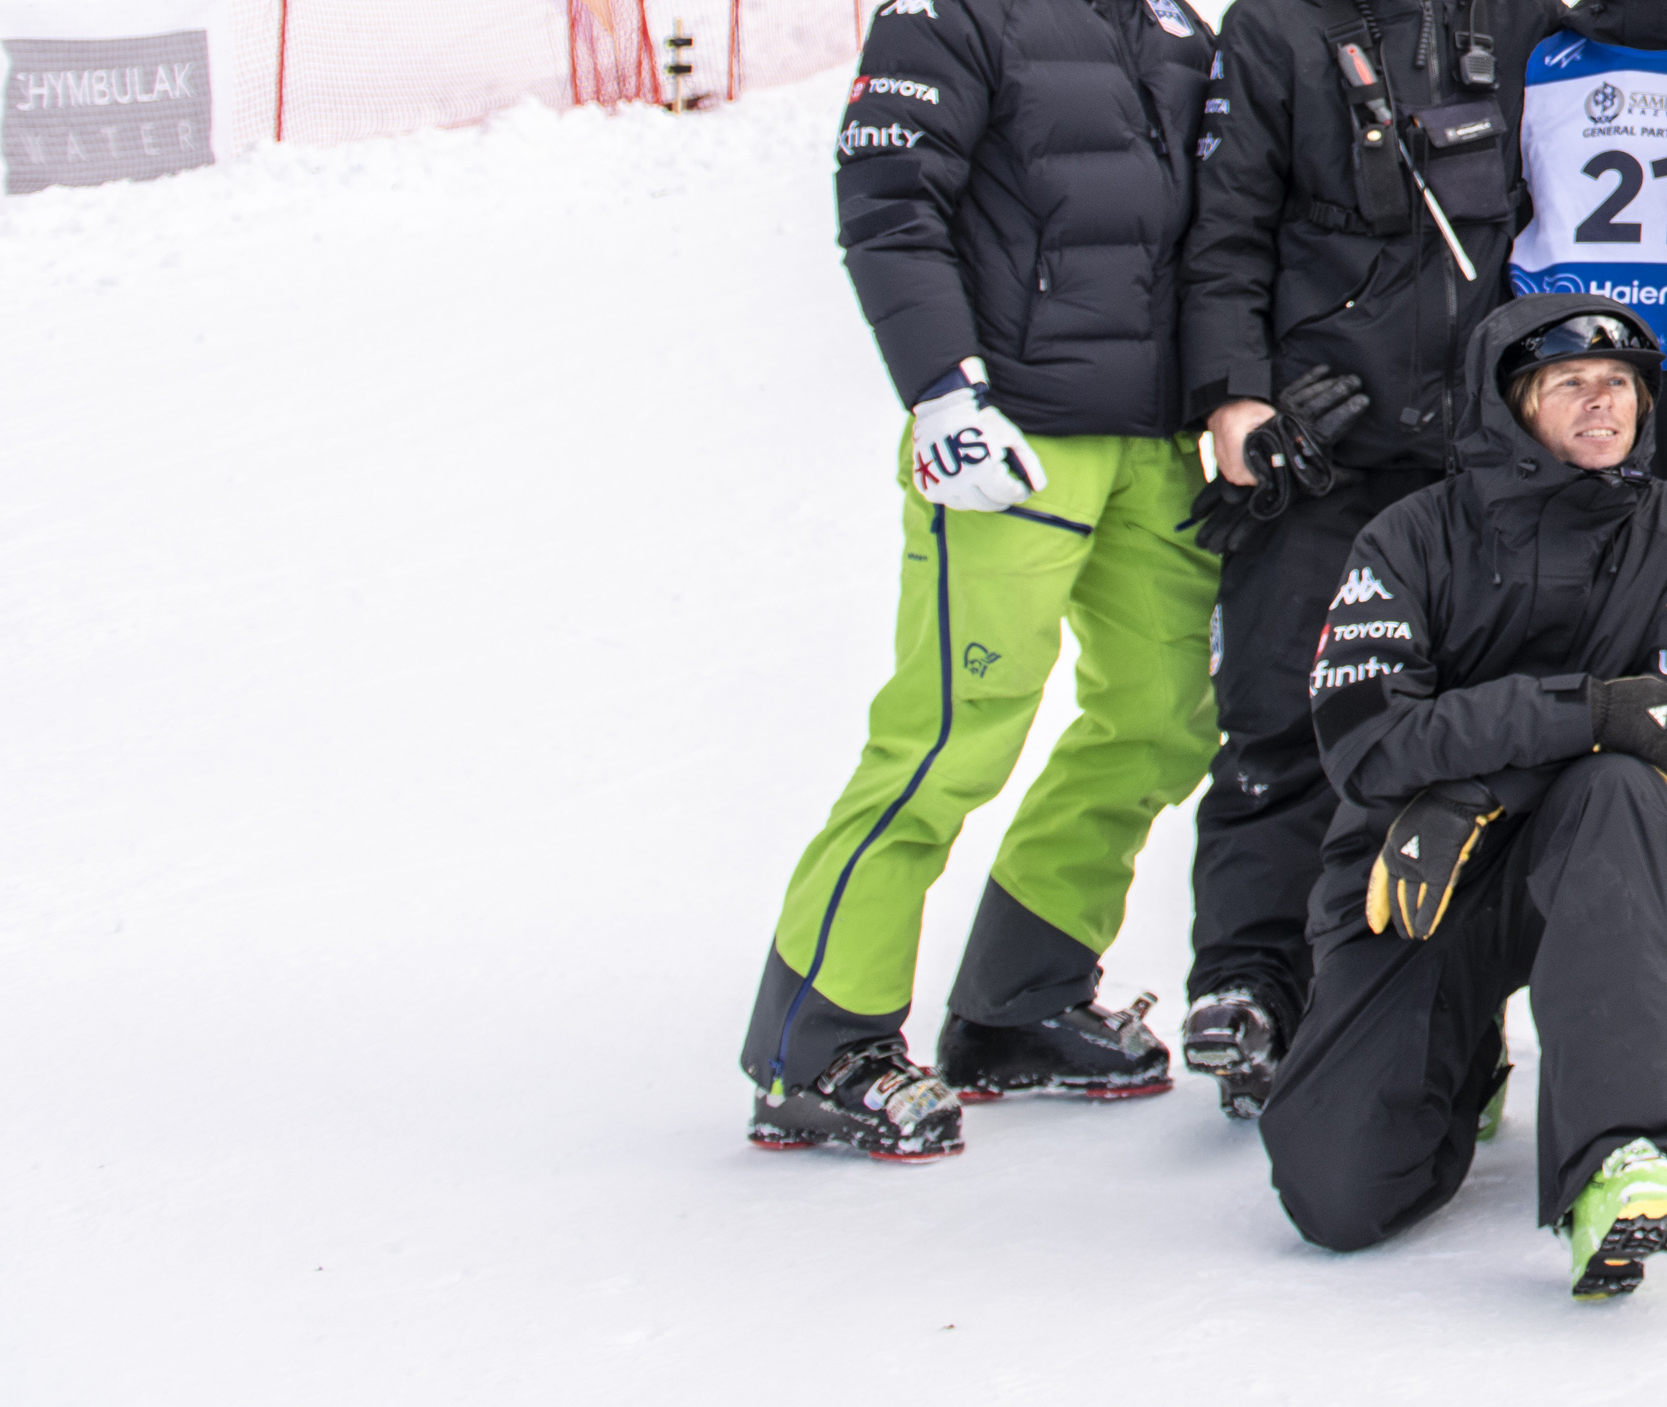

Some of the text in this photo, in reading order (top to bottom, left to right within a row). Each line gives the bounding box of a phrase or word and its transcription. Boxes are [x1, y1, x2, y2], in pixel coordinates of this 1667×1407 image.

[869, 77, 940, 105] TOYOTA
[1582, 125, 1636, 139] GENERAL
[930, 427, 991, 477] US
[1333, 620, 1412, 642] TOYOTA
